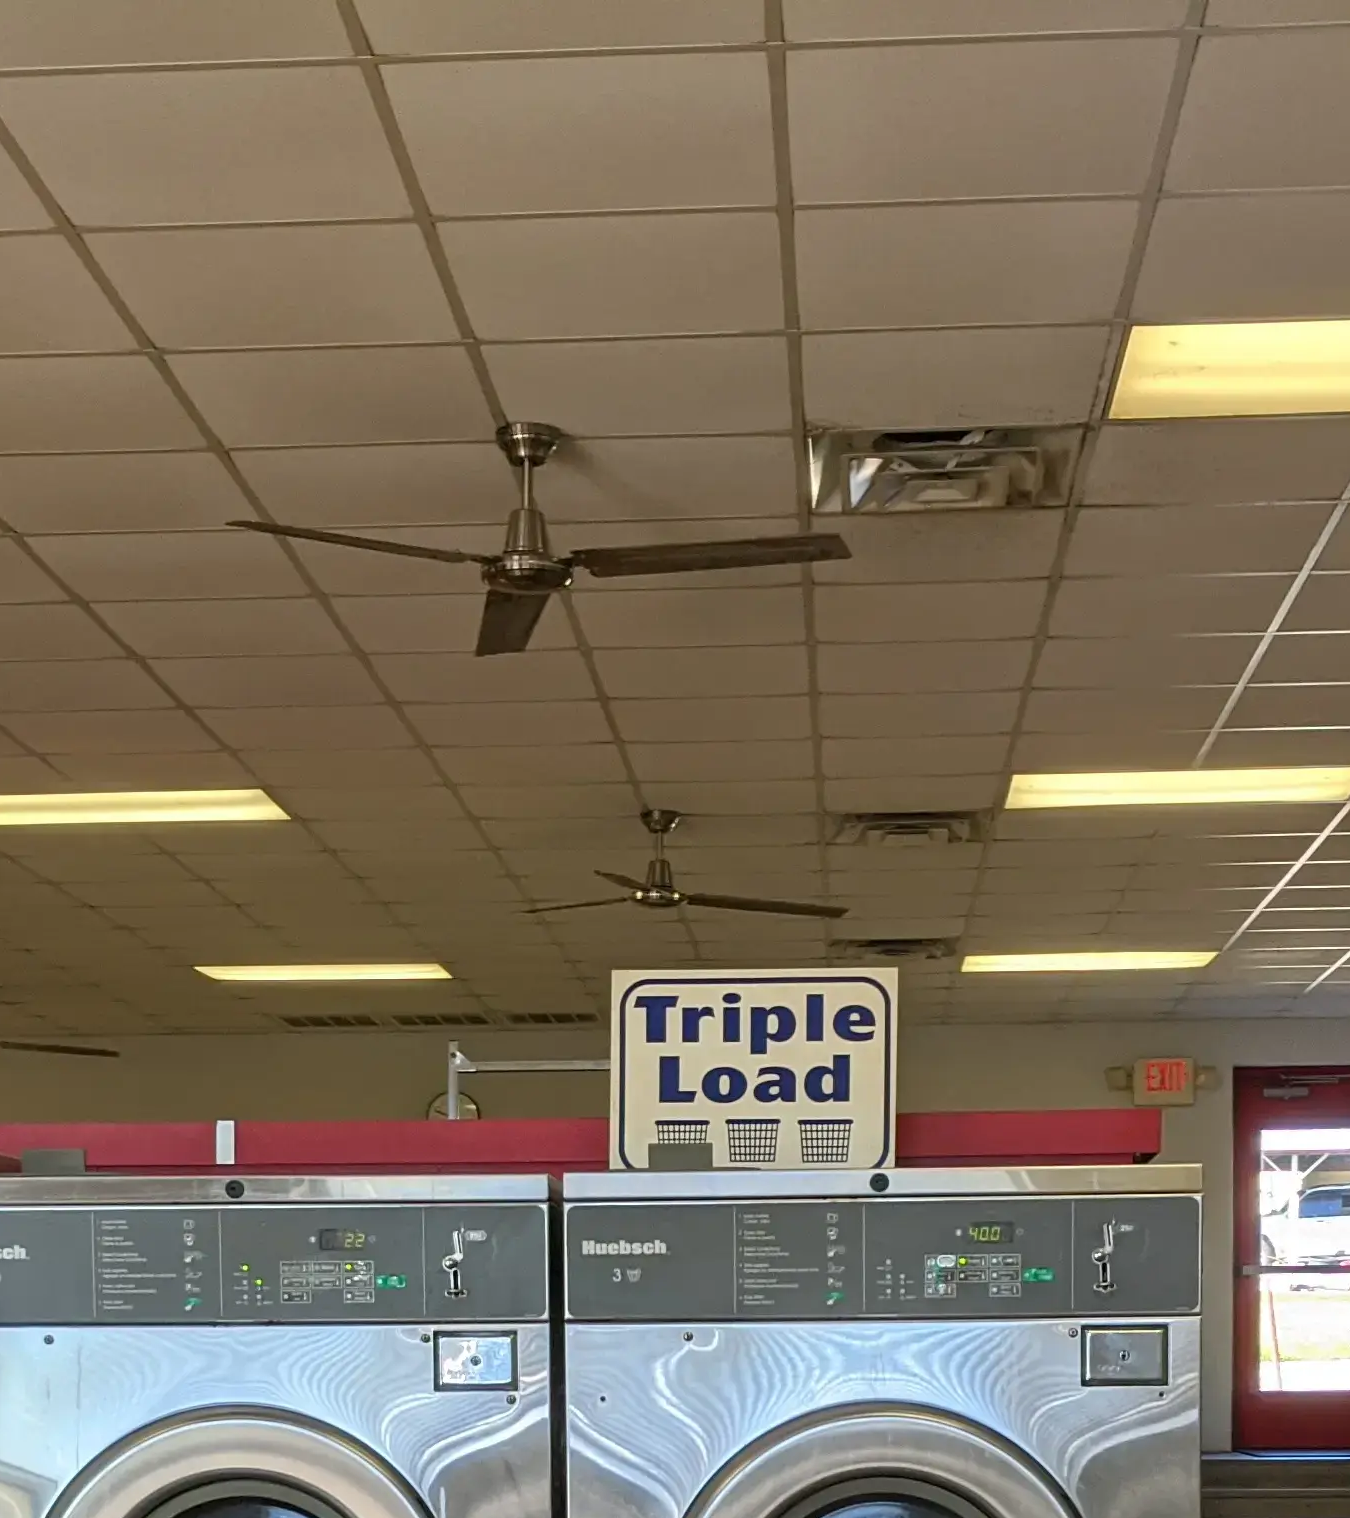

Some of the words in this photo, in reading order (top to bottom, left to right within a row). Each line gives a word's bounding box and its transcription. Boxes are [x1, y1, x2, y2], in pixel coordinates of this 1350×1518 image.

[634, 993, 876, 1055] Triple
[657, 1054, 852, 1103] Load
[1146, 1061, 1188, 1092] EXIT
[344, 1232, 366, 1248] 22
[582, 1239, 667, 1255] Huebsch
[612, 1267, 622, 1283] 3
